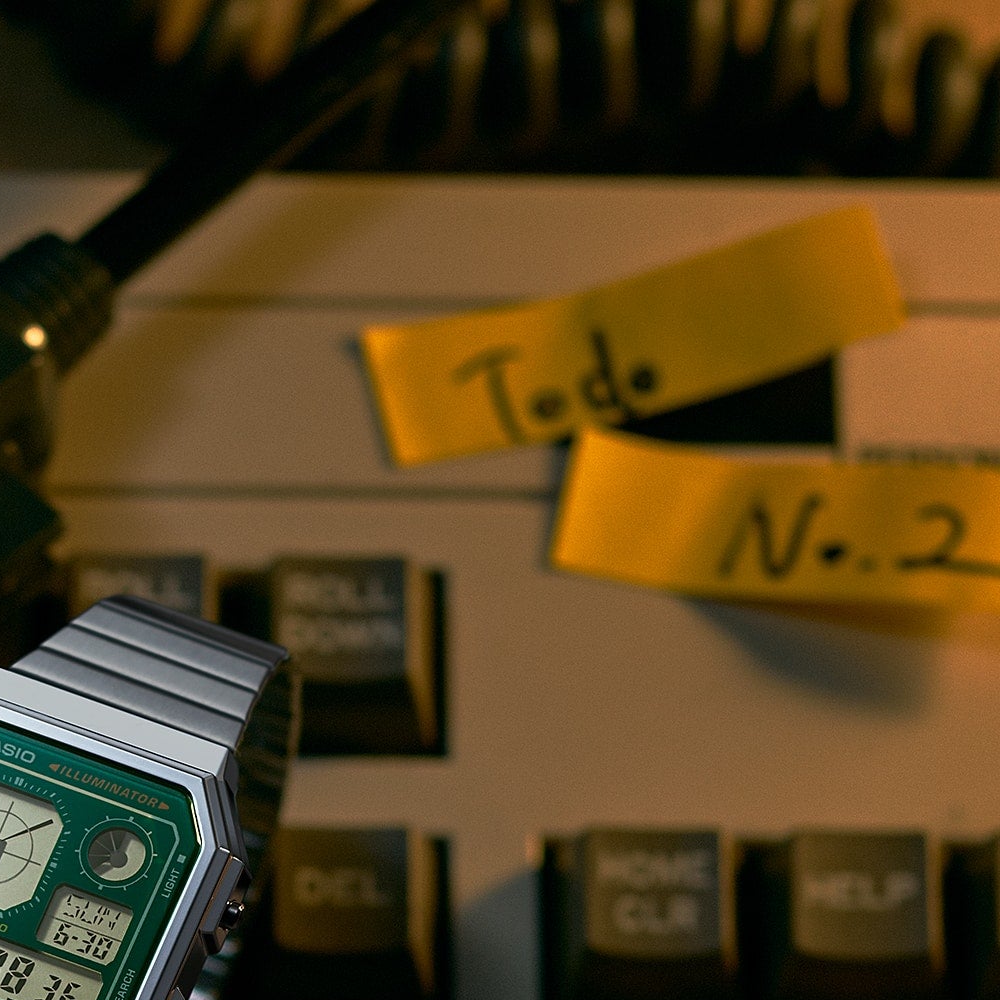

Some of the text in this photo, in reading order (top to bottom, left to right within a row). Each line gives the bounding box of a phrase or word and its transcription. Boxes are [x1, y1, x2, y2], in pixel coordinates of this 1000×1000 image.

[897, 502, 1000, 576] 2
[59, 765, 160, 809] ILLUMINATOR
[161, 867, 180, 899] LIGHT
[53, 922, 113, 960] 6-30
